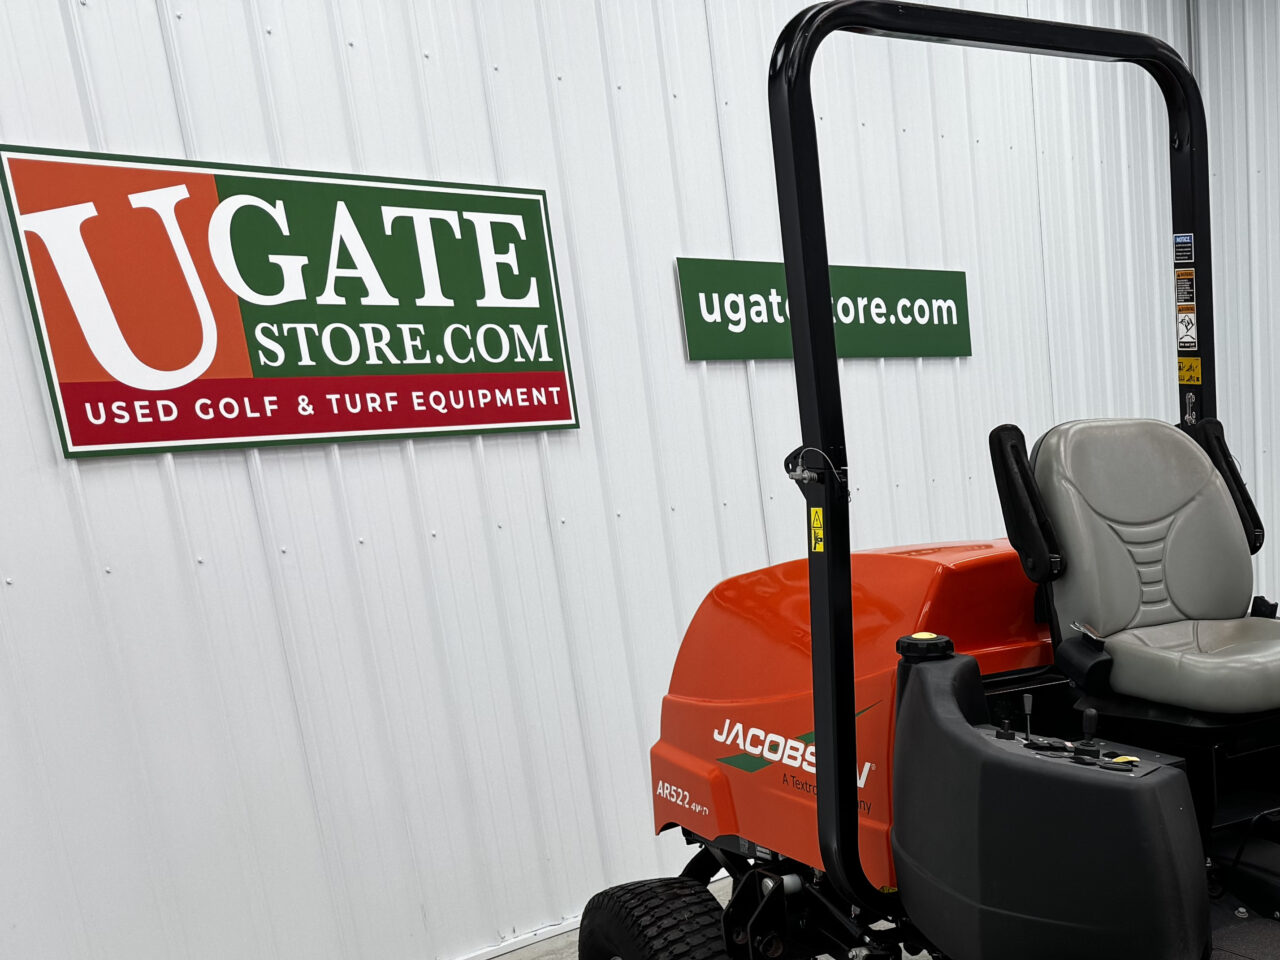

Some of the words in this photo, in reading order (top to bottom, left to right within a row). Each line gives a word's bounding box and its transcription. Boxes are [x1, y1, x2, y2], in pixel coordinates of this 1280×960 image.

[698, 288, 958, 333] ugatore.com
[253, 322, 554, 366] STORE.COM
[85, 400, 178, 426] USED
[197, 396, 279, 420] GOLF
[298, 394, 315, 416] &
[326, 392, 399, 415] TURF
[412, 387, 562, 411] EQUIPMENT
[713, 718, 871, 789] JACOBSN
[656, 779, 690, 808] AR522
[790, 775, 817, 796] Textro
